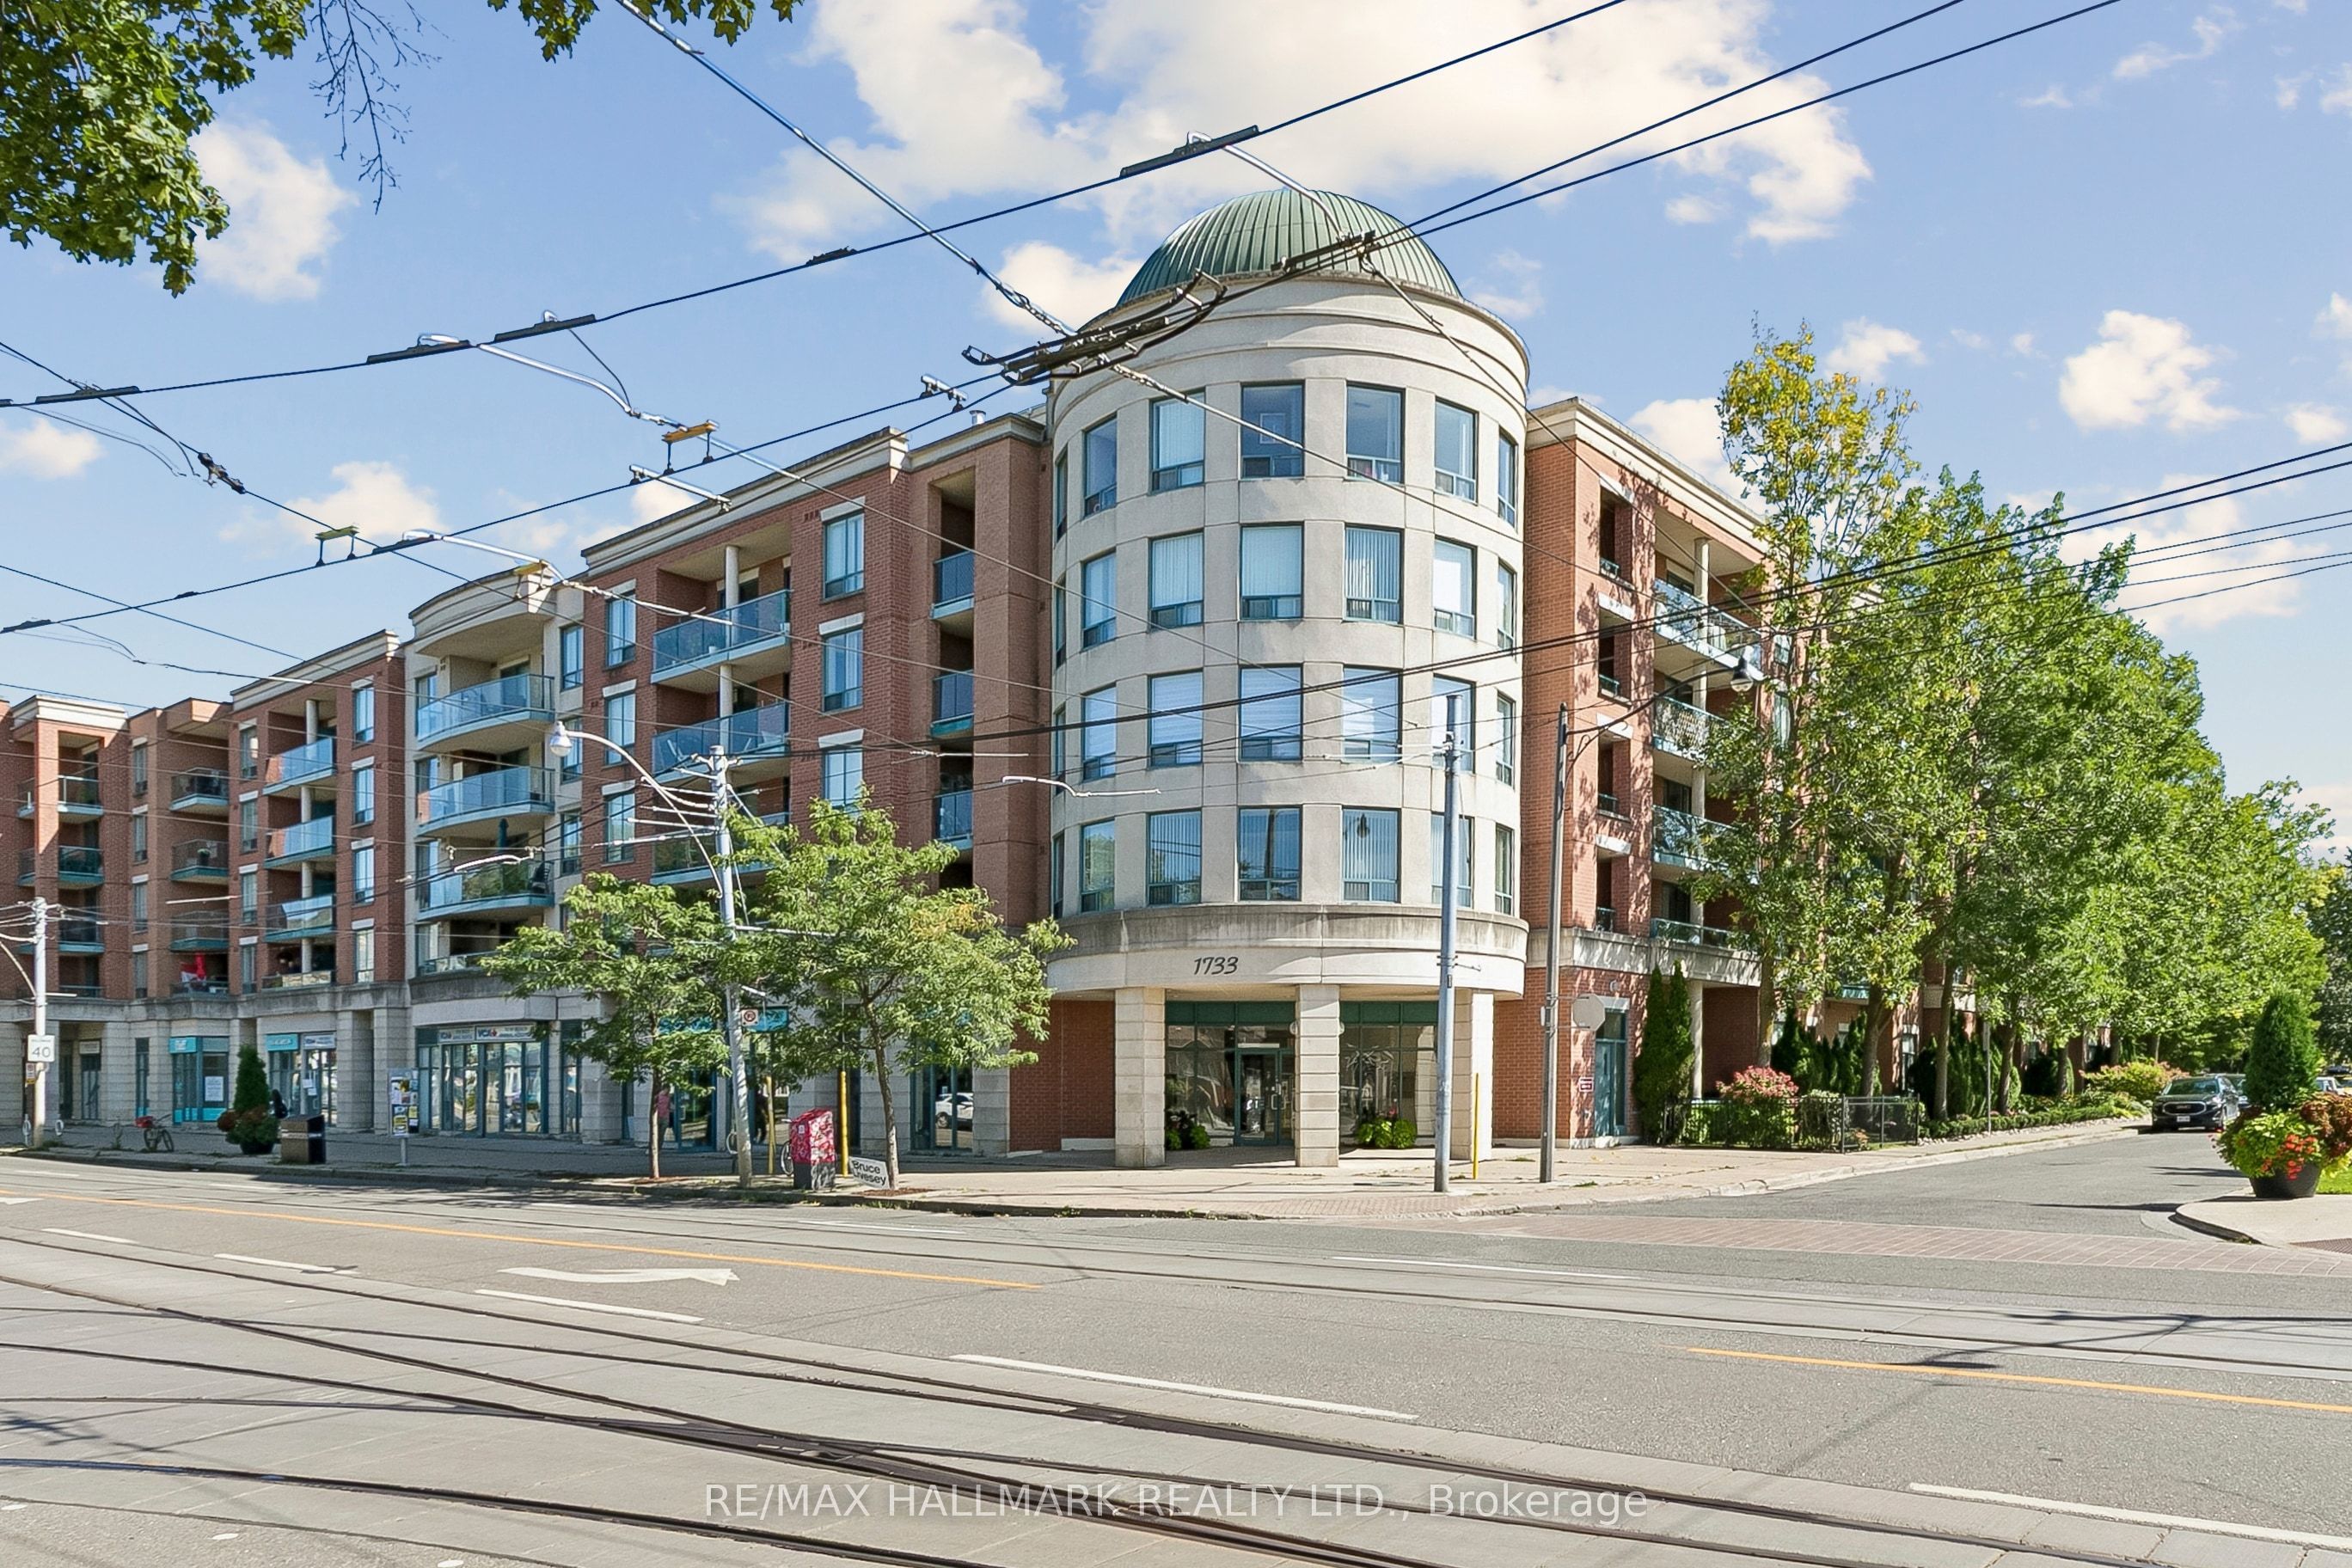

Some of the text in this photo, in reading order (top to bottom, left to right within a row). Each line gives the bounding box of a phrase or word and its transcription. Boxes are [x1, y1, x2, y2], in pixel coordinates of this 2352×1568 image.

[1194, 956, 1239, 975] 1733
[32, 1046, 51, 1058] 40
[852, 1161, 881, 1174] Bruce
